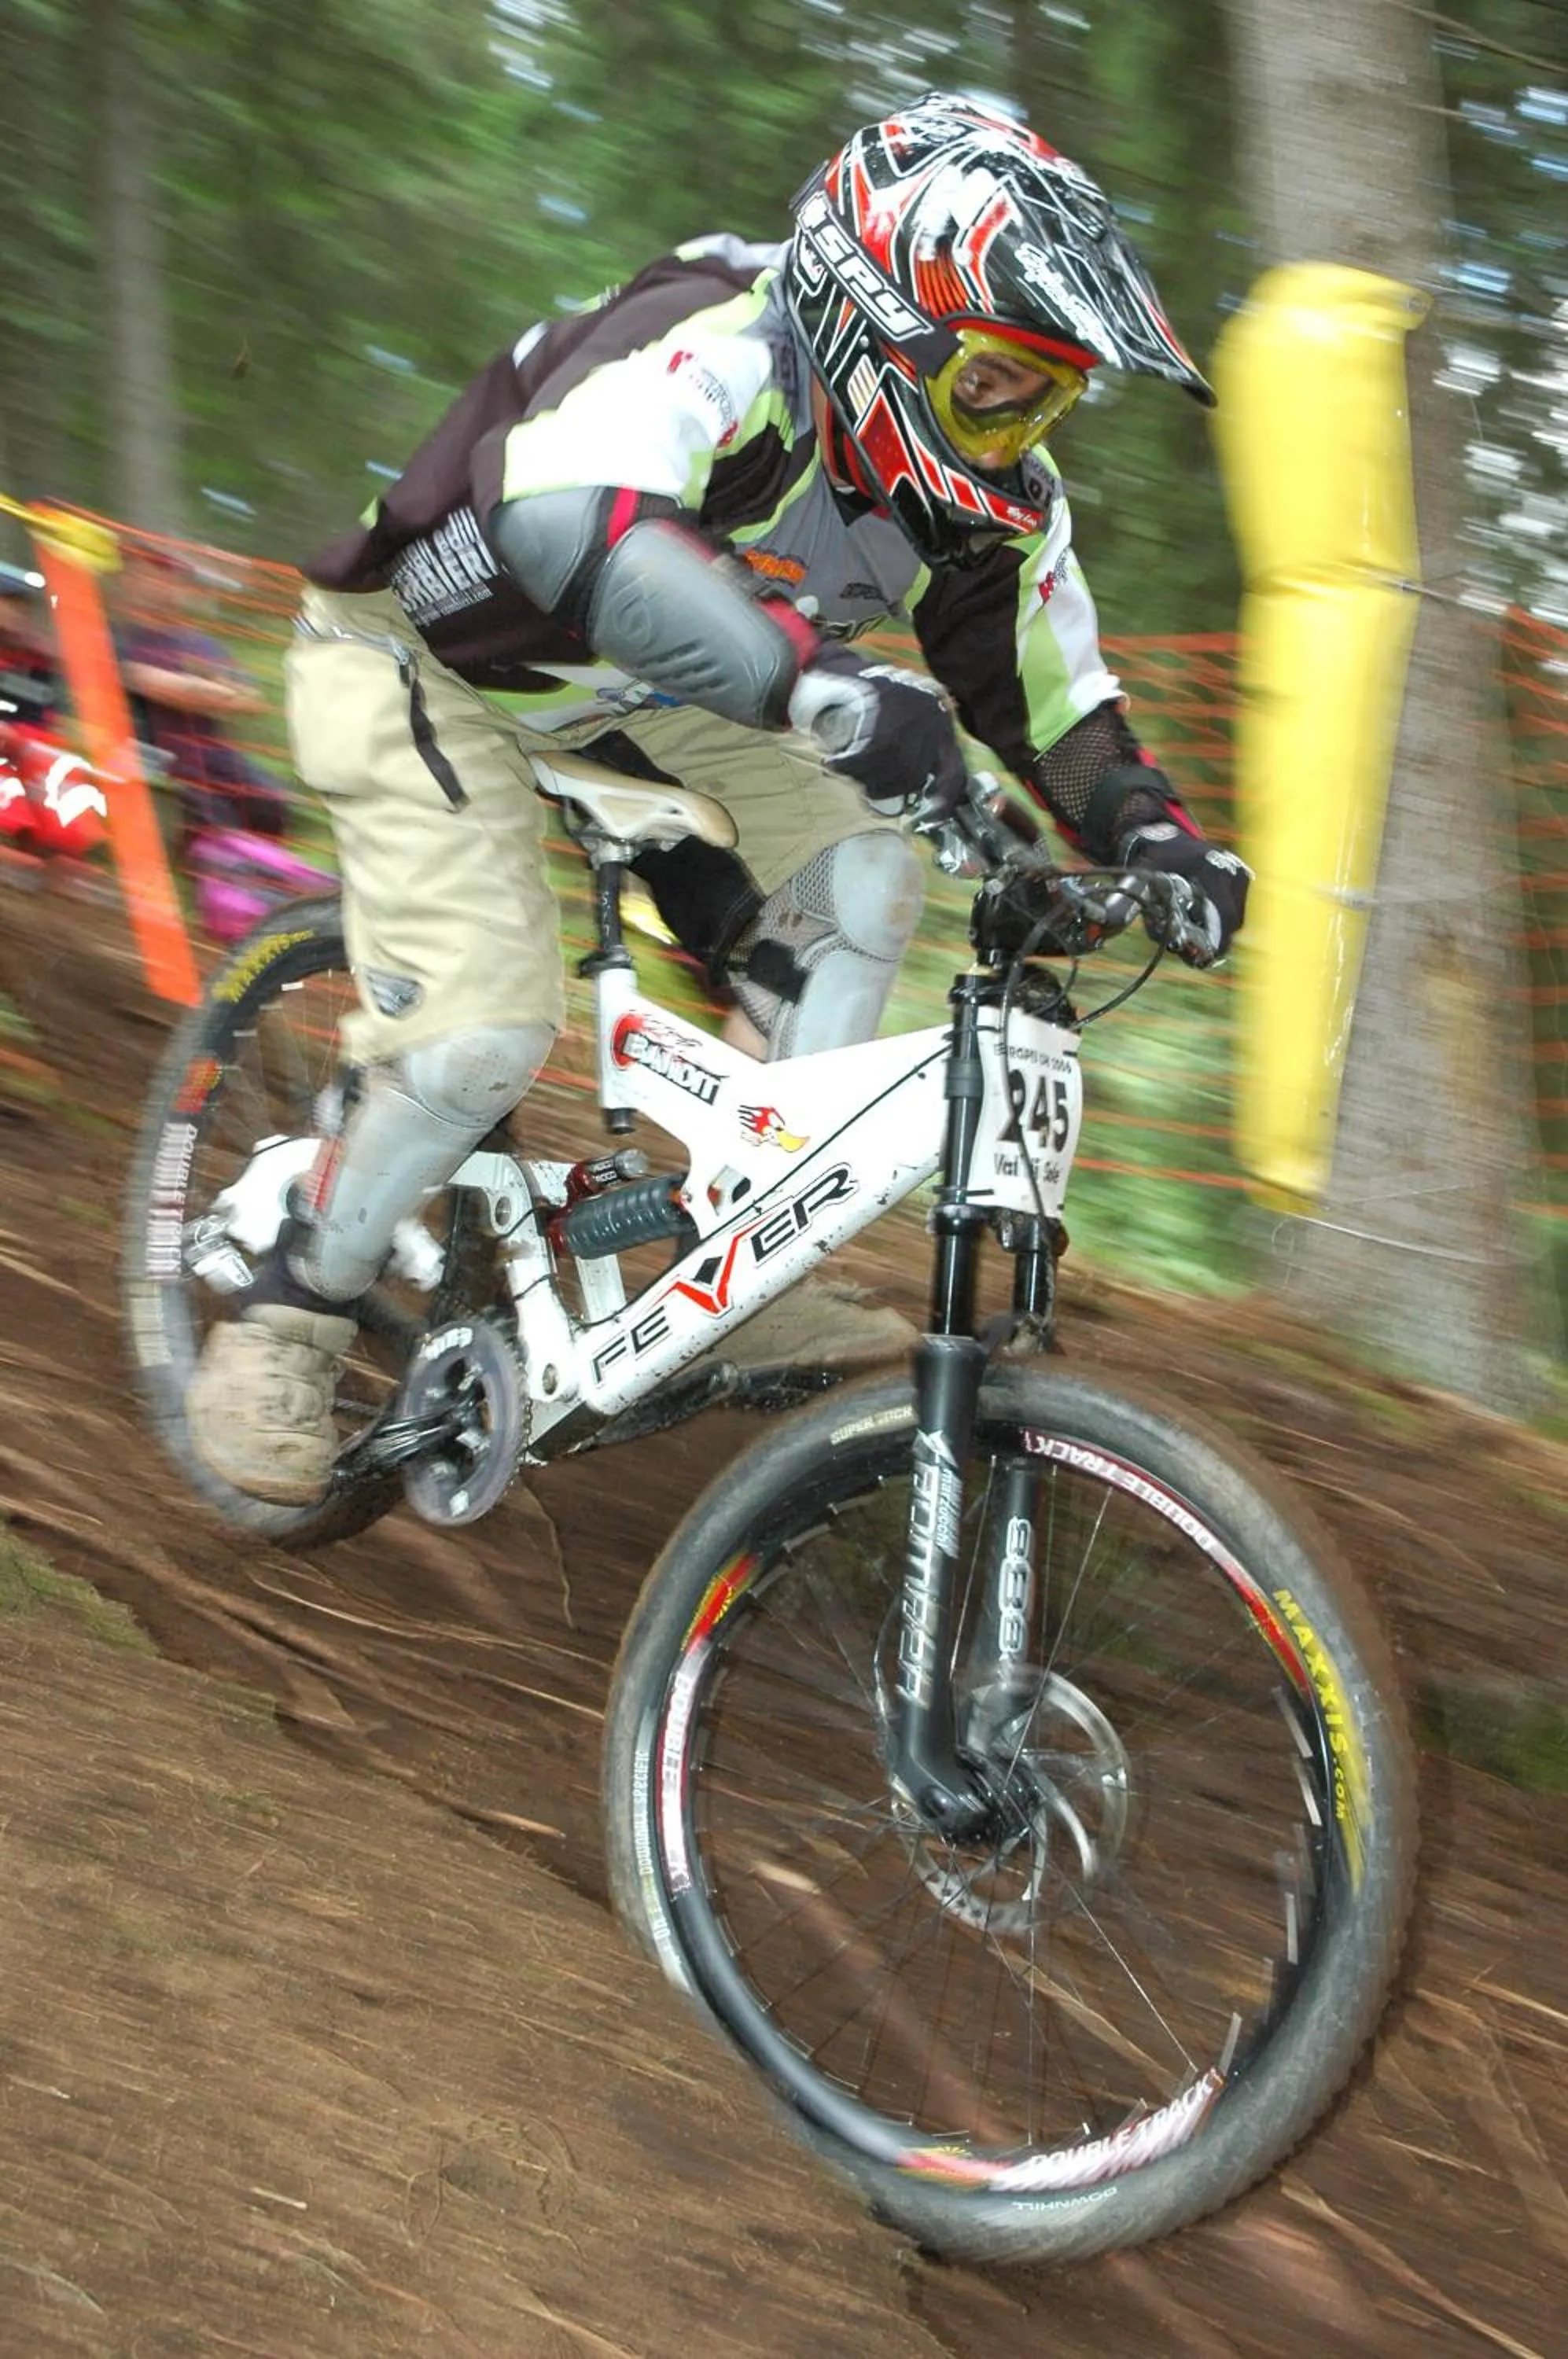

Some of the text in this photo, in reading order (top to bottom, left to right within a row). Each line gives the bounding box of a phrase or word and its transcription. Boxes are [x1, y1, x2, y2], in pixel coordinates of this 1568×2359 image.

[814, 224, 922, 333] SPY
[622, 1032, 720, 1105] BANDIT
[997, 1069, 1069, 1153] 245
[591, 1164, 858, 1384] FEVER
